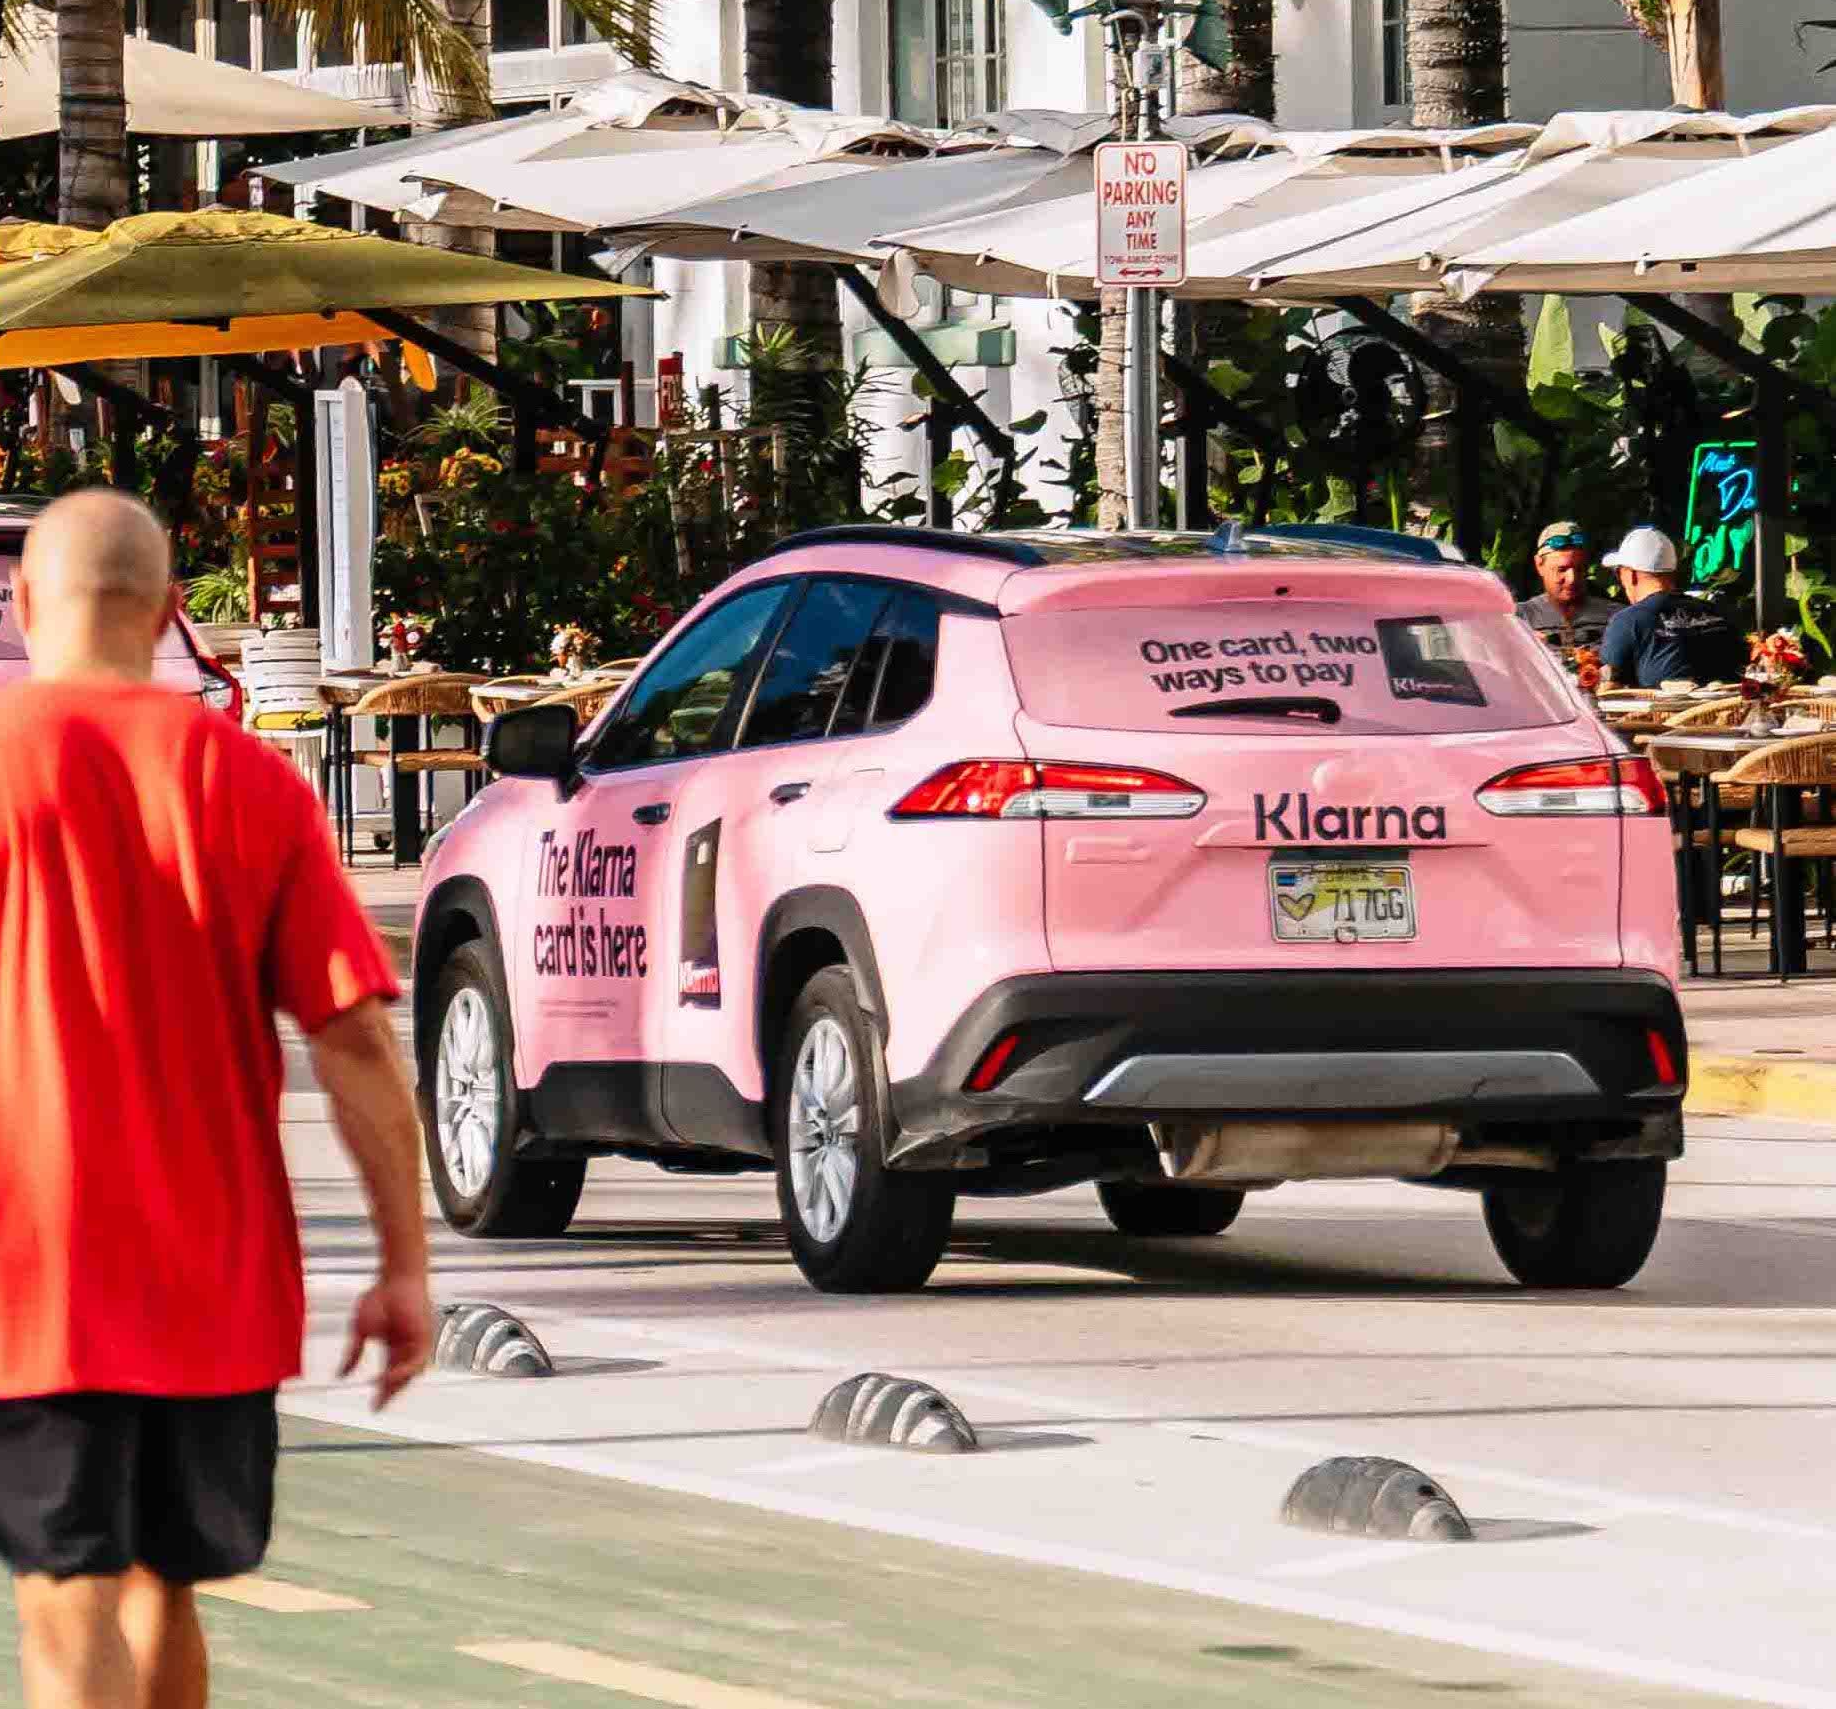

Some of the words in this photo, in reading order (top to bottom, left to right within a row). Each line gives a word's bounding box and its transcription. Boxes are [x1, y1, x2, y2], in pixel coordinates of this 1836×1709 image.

[1124, 152, 1157, 176] NO
[1103, 180, 1178, 206] PARKING
[1126, 211, 1157, 229] ANY
[1126, 232, 1158, 250] TIME
[1140, 638, 1212, 665] One
[1218, 630, 1307, 658] card,
[1308, 632, 1378, 656] two
[1150, 662, 1246, 693] ways
[1247, 660, 1288, 685] to
[1294, 660, 1355, 688] pay
[1253, 792, 1447, 841] Klarna
[536, 829, 569, 897] The
[573, 828, 638, 898] Klarna
[533, 907, 576, 977] card
[578, 905, 597, 977] is
[599, 907, 648, 979] here
